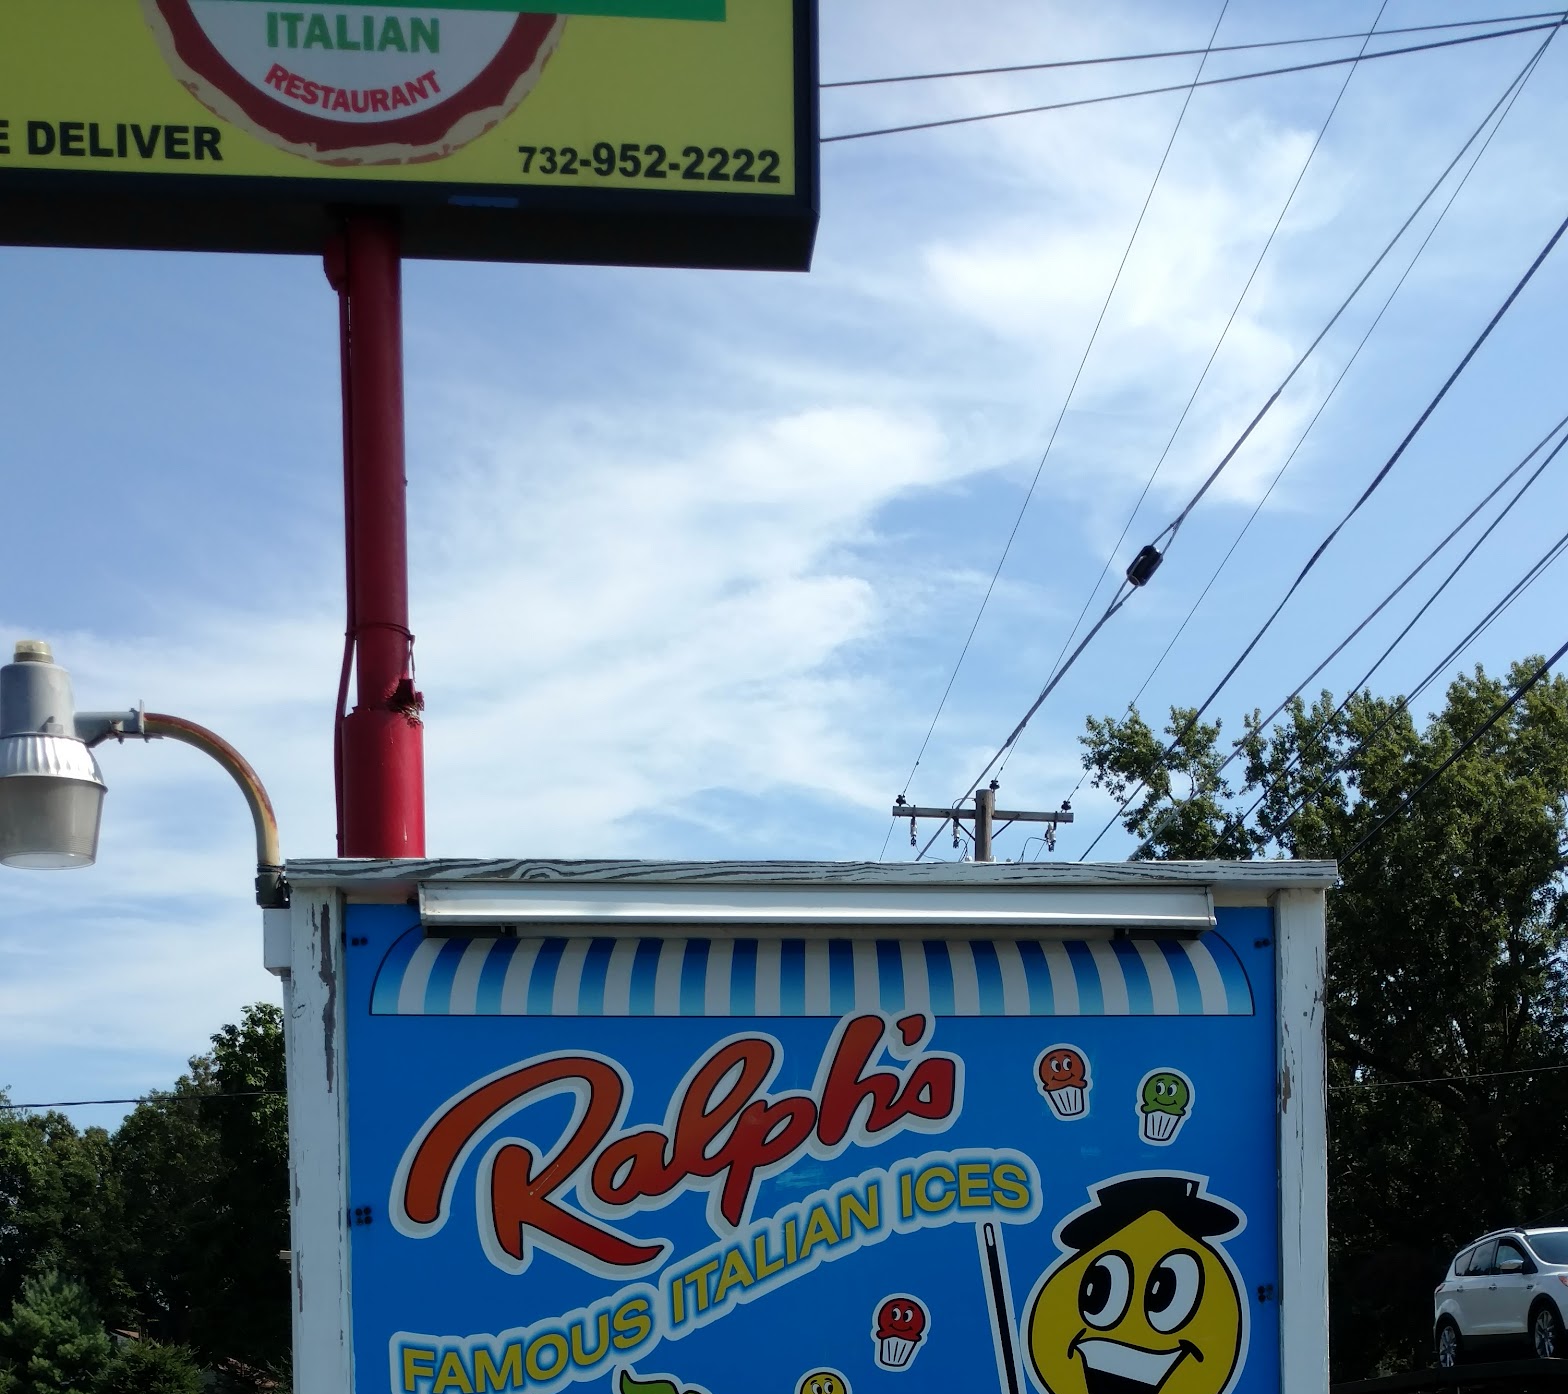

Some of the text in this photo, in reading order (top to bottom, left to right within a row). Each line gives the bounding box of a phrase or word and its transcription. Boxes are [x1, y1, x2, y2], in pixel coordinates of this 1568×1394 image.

[267, 12, 440, 53] ITALIAN
[264, 63, 441, 113] RESTAURANT
[27, 121, 223, 161] DELIVER
[518, 142, 782, 184] 732-952-2222
[404, 1014, 957, 1266] Ralph's
[404, 1163, 1030, 1394] FAMOUS ITALIAN ICES
